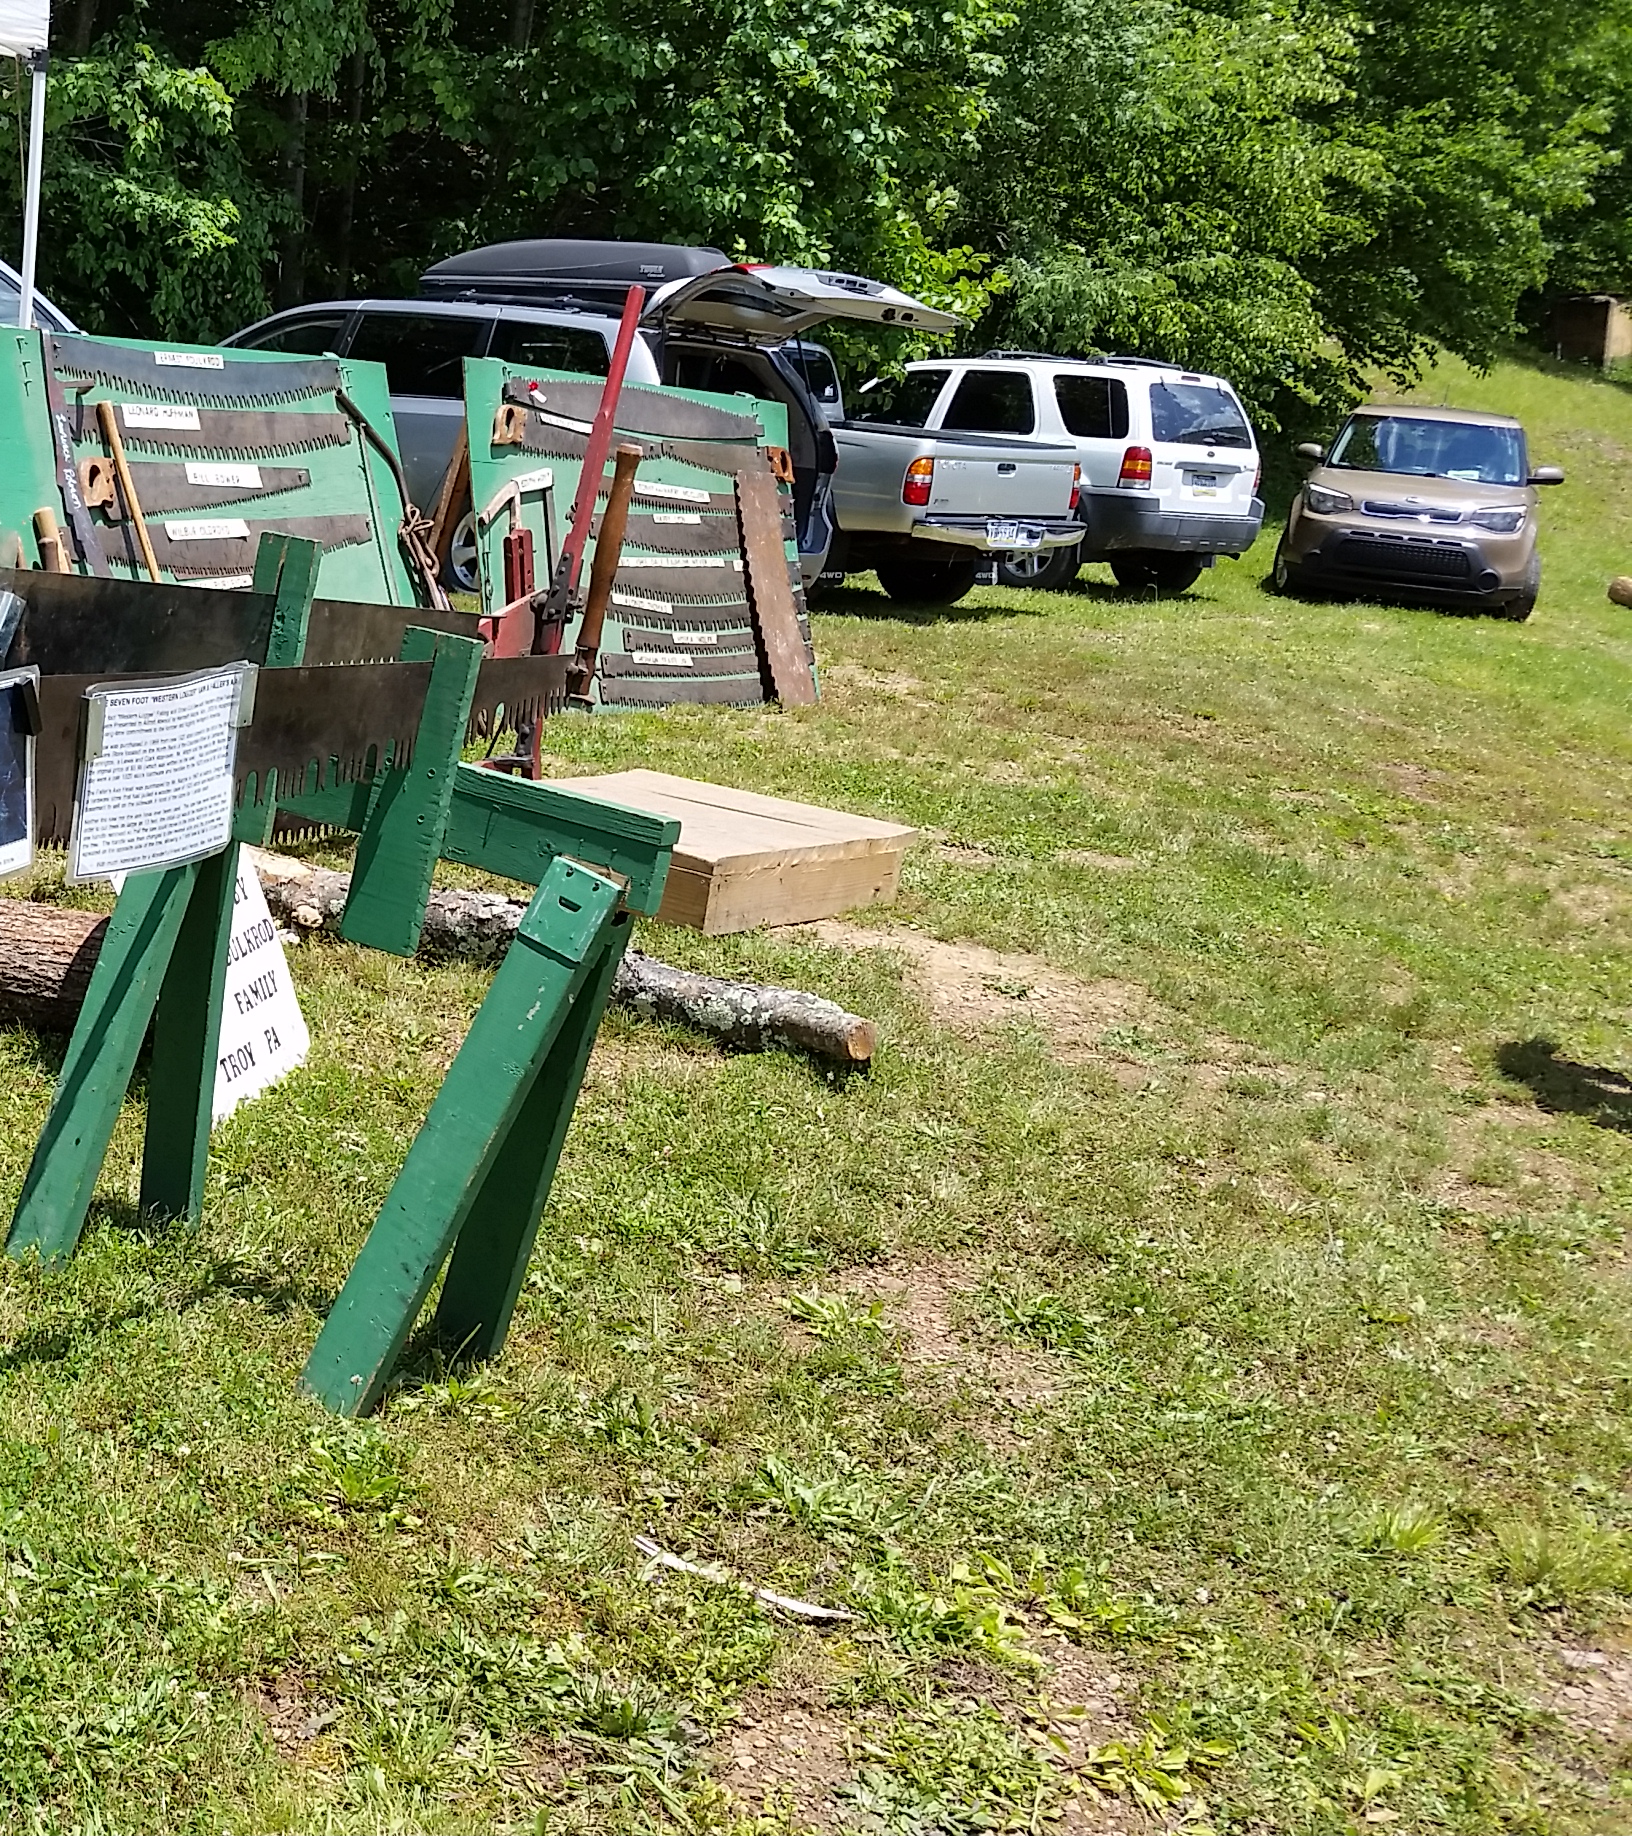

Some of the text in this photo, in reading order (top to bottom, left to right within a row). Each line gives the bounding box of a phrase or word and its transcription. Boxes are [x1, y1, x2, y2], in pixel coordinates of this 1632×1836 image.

[819, 571, 843, 579] 4WD
[975, 572, 995, 580] 4WD
[110, 697, 130, 706] SEVEN
[132, 696, 148, 704] FOOT
[225, 917, 274, 967] OULKROD
[233, 970, 279, 1015] FAMILY
[219, 1026, 282, 1083] TROY PA
